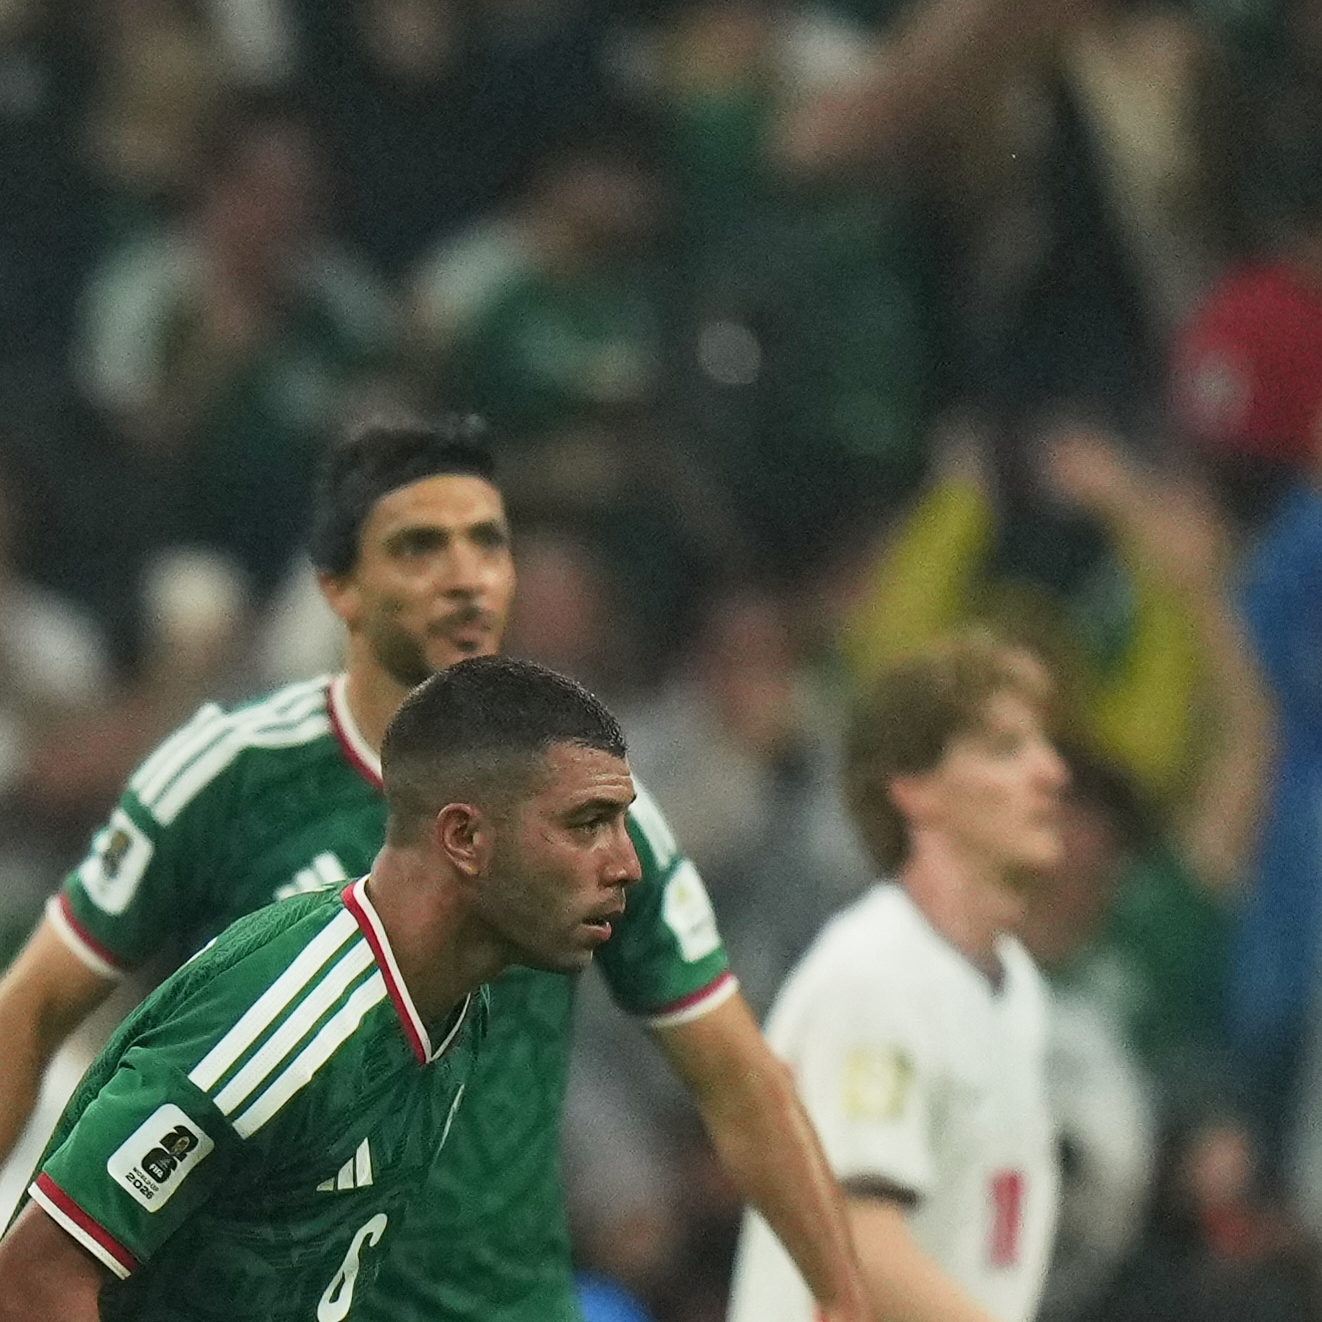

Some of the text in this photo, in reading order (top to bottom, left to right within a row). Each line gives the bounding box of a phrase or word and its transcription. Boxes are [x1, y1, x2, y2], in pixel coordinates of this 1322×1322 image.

[132, 1166, 151, 1185] WORLD
[148, 1163, 164, 1179] FIFA
[125, 1172, 155, 1200] 2026
